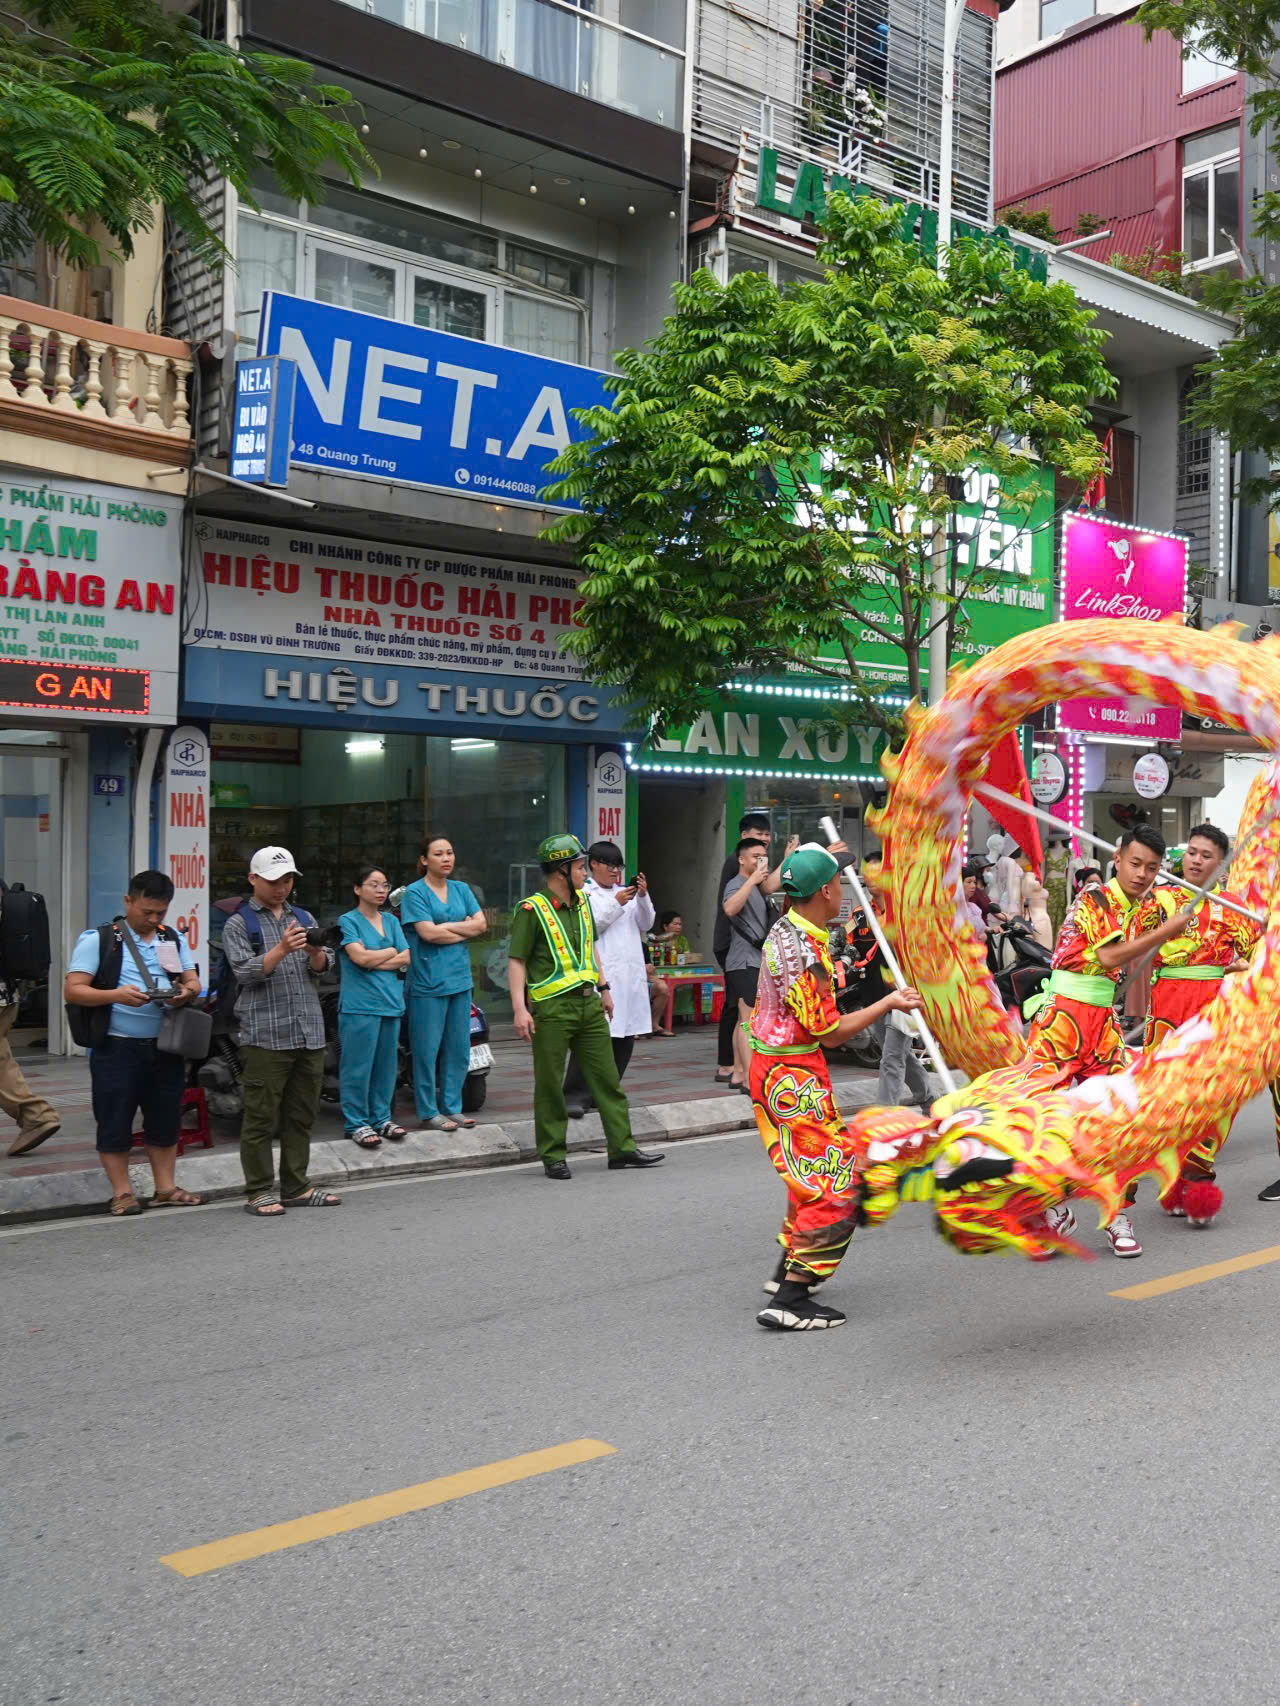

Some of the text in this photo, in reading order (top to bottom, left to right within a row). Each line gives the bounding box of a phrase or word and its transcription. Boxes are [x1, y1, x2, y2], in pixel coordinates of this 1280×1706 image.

[239, 368, 271, 392] NET.A
[279, 326, 573, 461] NET.A
[298, 443, 397, 472] 48 Quang Trung
[473, 474, 536, 495] 0914446088
[70, 495, 100, 518] HẢI
[107, 501, 168, 527] PHÒNG
[216, 528, 270, 546] HAIPHARCO
[289, 539, 314, 554] CHI
[318, 542, 363, 562] NHÁNH
[367, 548, 402, 568] CÔNG
[406, 556, 420, 570] TY
[424, 559, 440, 572] CP
[517, 569, 536, 585] HẢI
[539, 574, 576, 590] PHÒNG
[115, 578, 175, 615] AN
[203, 551, 300, 596] HIỆU
[314, 567, 445, 612] THUỐC
[458, 583, 516, 620] HẢI
[35, 609, 68, 624] LAN
[72, 613, 105, 628] ANH
[296, 623, 315, 636] Bán
[324, 605, 546, 645] NHÀ THUỐC SỐ 4
[40, 643, 65, 659] HẢI
[69, 648, 117, 663] PHÒNG
[528, 662, 538, 671] 48
[541, 663, 565, 674] Quang
[567, 665, 587, 675] Trun
[36, 673, 112, 700] G AN
[264, 667, 600, 721] HIỆU THUỐC
[100, 778, 119, 792] 49
[170, 786, 206, 828] NHÀ
[170, 842, 206, 889] THUỐC
[549, 849, 571, 860] CSTT
